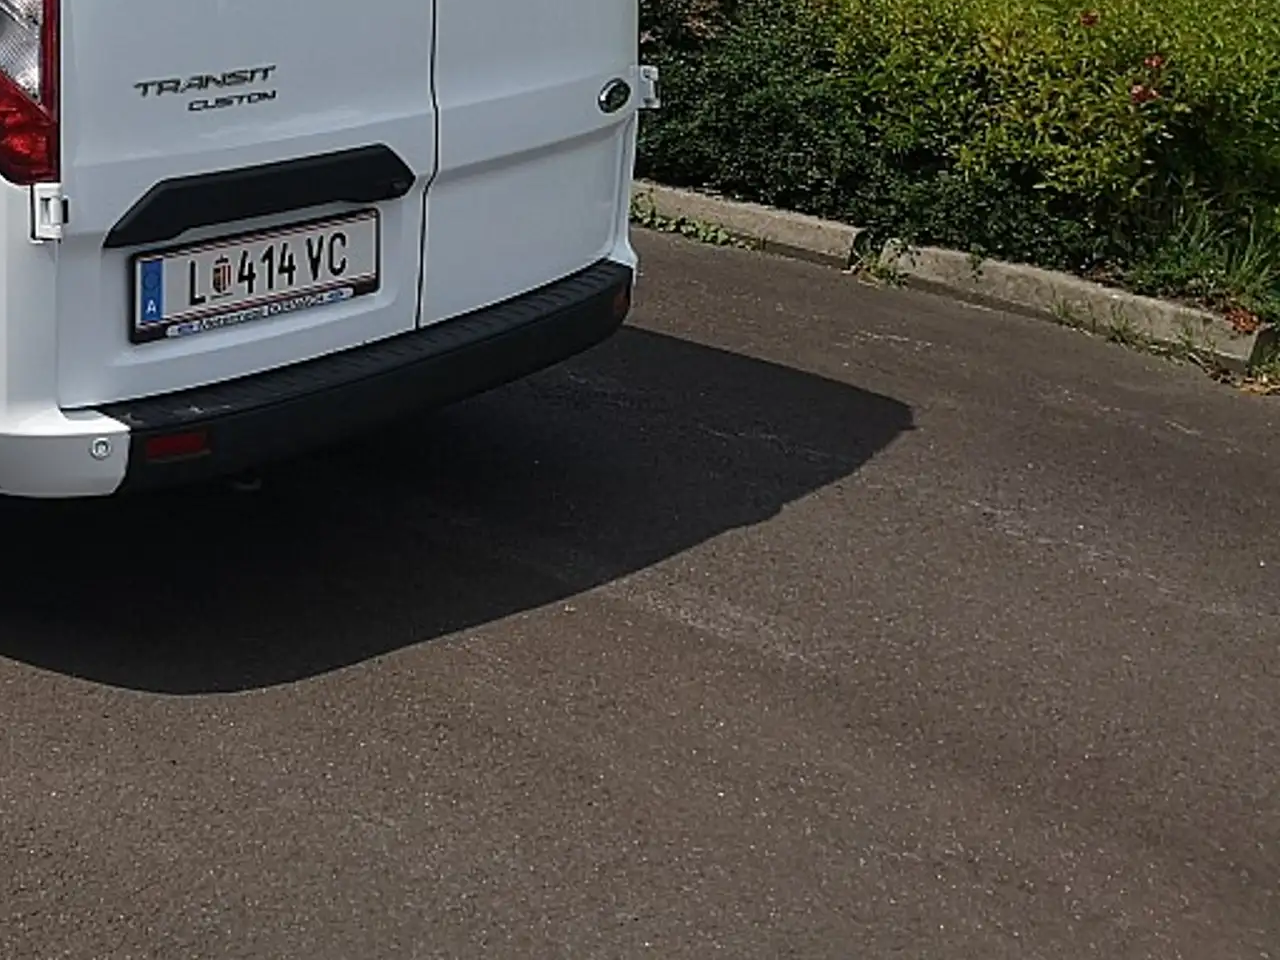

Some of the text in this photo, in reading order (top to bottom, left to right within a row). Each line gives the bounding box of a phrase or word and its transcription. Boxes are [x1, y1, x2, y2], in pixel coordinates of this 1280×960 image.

[134, 65, 276, 97] TRANSIT
[188, 90, 276, 112] CUSTOM
[237, 243, 296, 294] 414
[306, 232, 347, 281] VC
[145, 299, 157, 314] A
